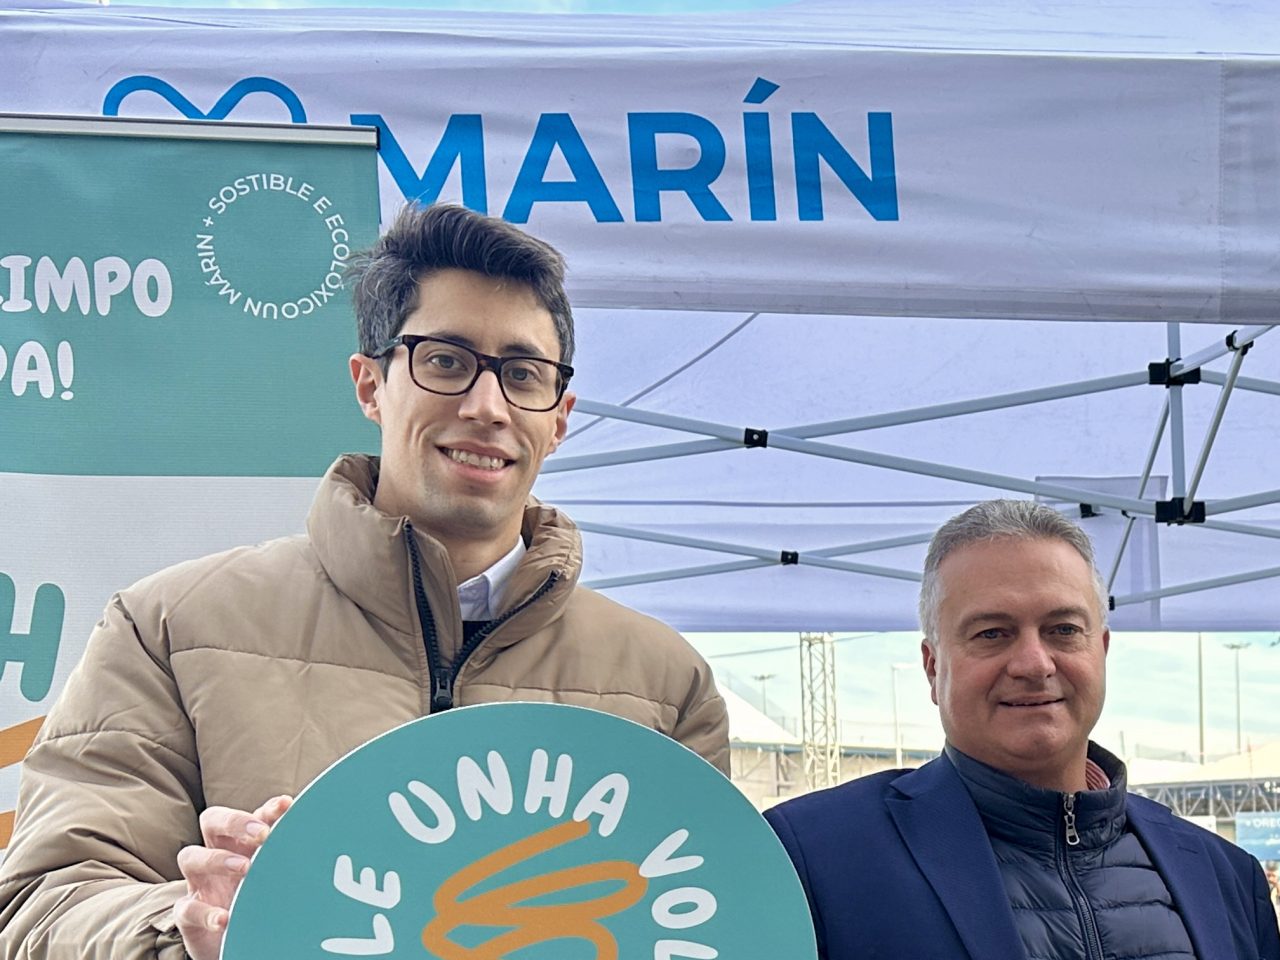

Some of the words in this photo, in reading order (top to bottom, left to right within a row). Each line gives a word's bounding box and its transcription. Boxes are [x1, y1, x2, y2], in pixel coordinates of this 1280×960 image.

[350, 77, 899, 222] MARÍN
[208, 173, 315, 215] SOSTIBLE
[313, 196, 332, 215] E
[0, 254, 173, 317] IMPO
[388, 748, 630, 844] UNHA
